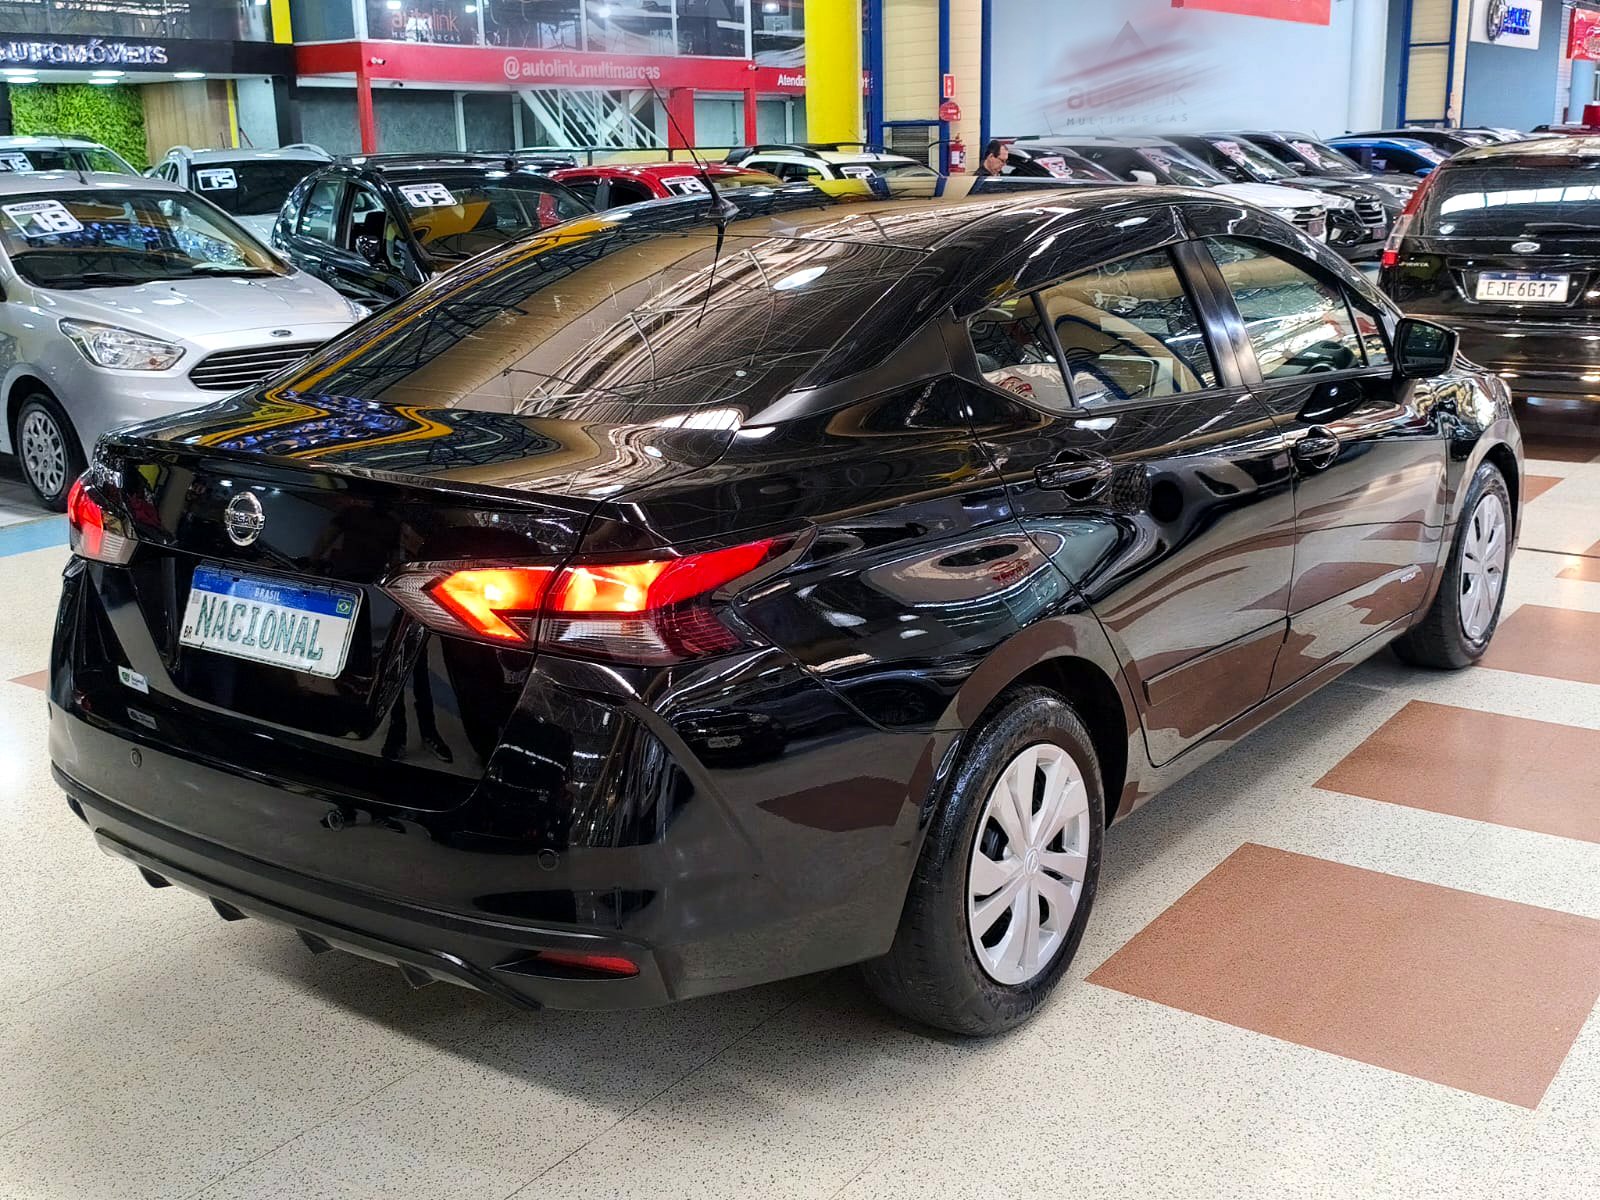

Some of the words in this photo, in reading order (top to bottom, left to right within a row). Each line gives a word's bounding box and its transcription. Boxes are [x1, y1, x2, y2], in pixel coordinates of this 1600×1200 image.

[1066, 113, 1189, 126] MULTIMARCAS
[32, 210, 80, 231] 18
[1486, 281, 1557, 298] EJE6G17
[254, 587, 281, 601] BRASIL
[183, 625, 193, 640] BR
[195, 594, 323, 661] NACIONAL
